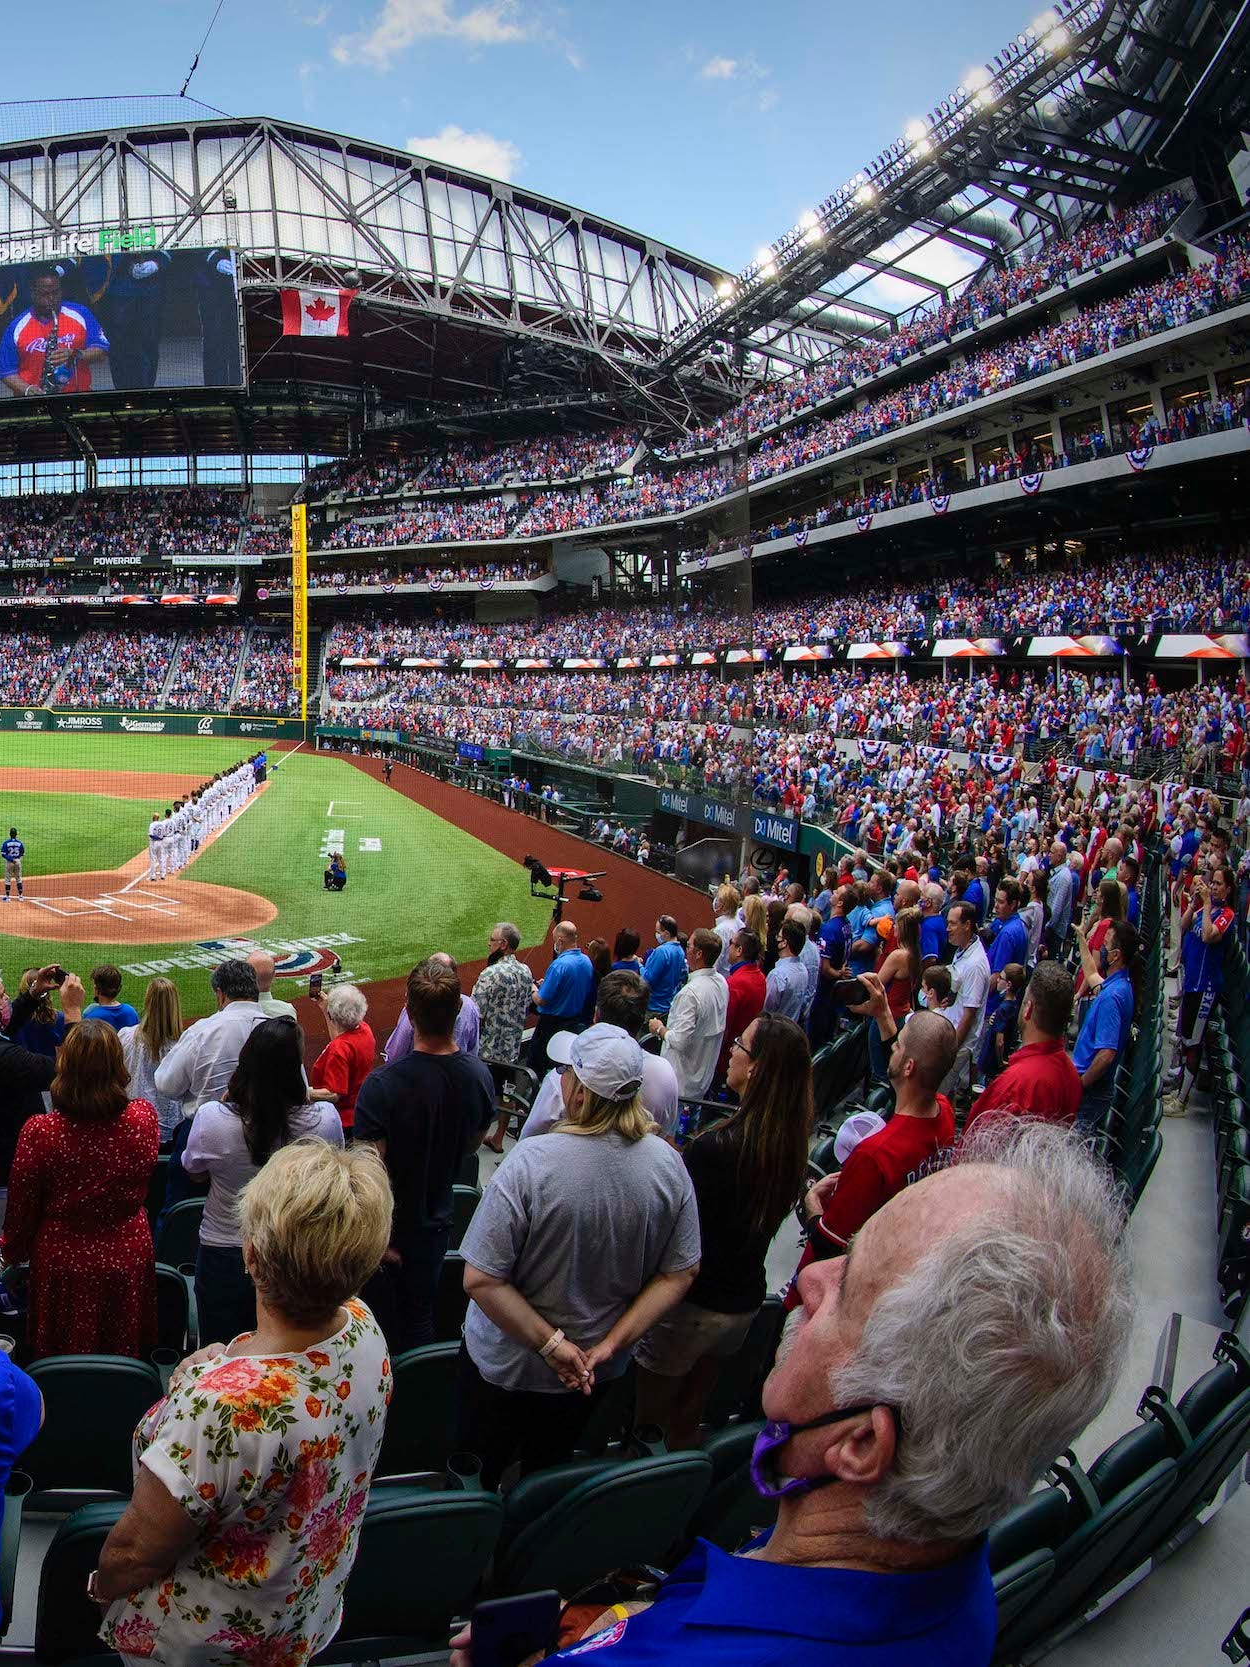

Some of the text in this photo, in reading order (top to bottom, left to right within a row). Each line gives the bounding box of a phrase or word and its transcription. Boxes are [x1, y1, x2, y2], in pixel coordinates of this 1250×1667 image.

[49, 232, 93, 254] Life
[99, 226, 156, 249] Field
[93, 557, 142, 566] POWERADE
[132, 722, 165, 731] Germania
[670, 793, 688, 814] Mitel
[714, 804, 736, 827] Mitel
[766, 818, 793, 845] Mitel
[268, 932, 367, 953] WEEK
